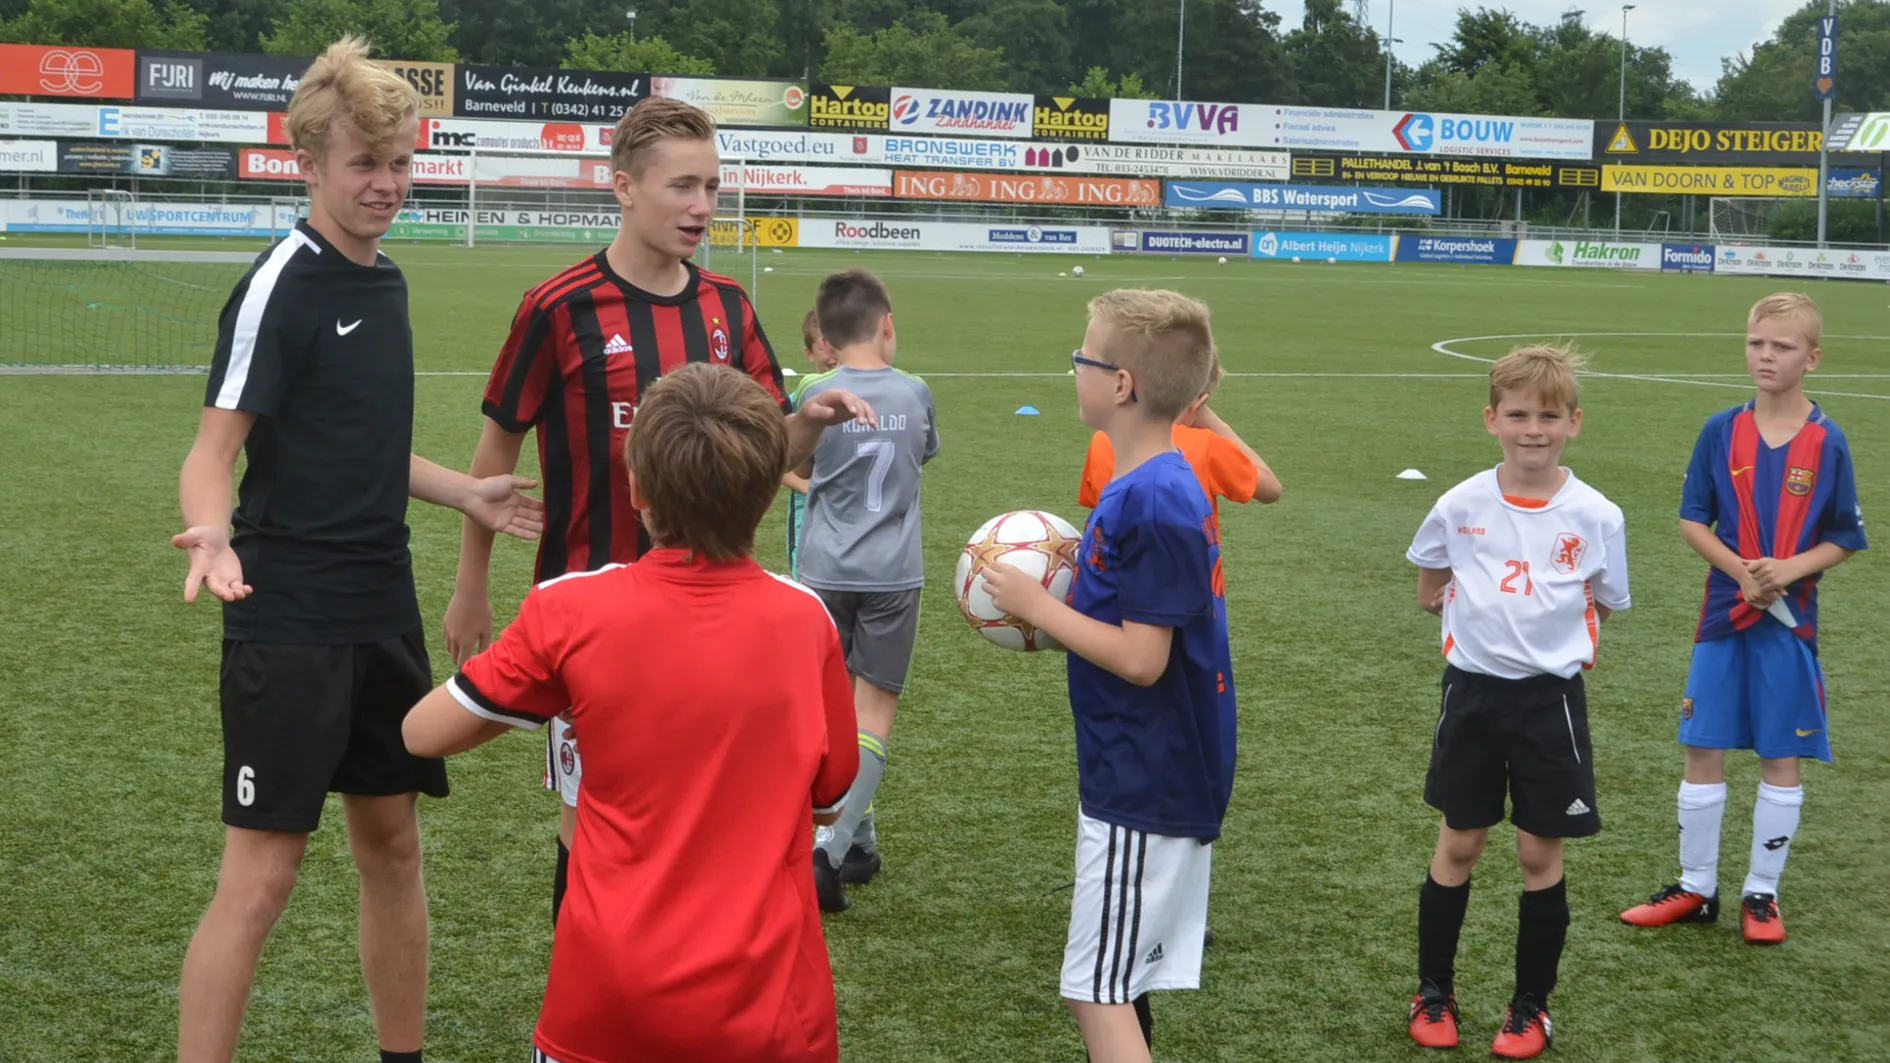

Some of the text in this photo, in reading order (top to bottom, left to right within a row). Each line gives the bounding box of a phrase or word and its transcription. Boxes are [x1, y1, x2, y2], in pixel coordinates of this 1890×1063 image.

[209, 71, 235, 91] Wij
[234, 73, 280, 89] maken
[465, 71, 639, 97] Van Ginkel Keukens.nl
[465, 99, 525, 113] Barneveld
[551, 102, 589, 116] (0342)
[591, 105, 605, 116] 41
[609, 105, 623, 116] 25
[811, 95, 889, 119] Hartog
[926, 98, 1029, 123] ZANDINK
[810, 118, 888, 129] CONTAINERS
[935, 114, 1016, 131] Zandhandel
[1034, 107, 1108, 131] Hartog
[1034, 129, 1107, 139] CONTAINERS
[1441, 119, 1514, 142] BOUW
[719, 134, 834, 158] Vastgoed.eu
[885, 139, 1017, 156] BRONSWERK
[1439, 146, 1474, 154] LOGISTIC
[1476, 147, 1511, 156] SERVICES
[1648, 129, 1711, 154] DEJO
[884, 153, 917, 164] HEAT
[924, 155, 993, 167] TRANSFER
[999, 158, 1016, 168] BV
[1084, 146, 1111, 158] VAN
[1115, 148, 1131, 159] DE
[1136, 148, 1184, 160] RIDDER
[1342, 157, 1412, 170] PALLETHANDEL
[1453, 161, 1480, 173] Bosch
[1505, 164, 1552, 176] Barneveld
[723, 167, 807, 187] in Nijkerk.
[1612, 171, 1775, 189] VAN DOORN & TOP
[900, 177, 1122, 202] ING ING ING
[1253, 188, 1358, 209] BBS Watersport
[150, 208, 251, 223] SPORTCENTRUM
[518, 213, 531, 224] &
[835, 221, 920, 240] Roodbeen
[1149, 236, 1242, 250] DUOTECH-electra.nl
[1282, 239, 1384, 256] Albert Heijn Nijkerk
[1434, 239, 1494, 253] Korpershoek
[1573, 241, 1641, 260] Hakron
[1664, 246, 1712, 265] Formido
[854, 438, 895, 512] 7
[237, 765, 255, 807] 6
